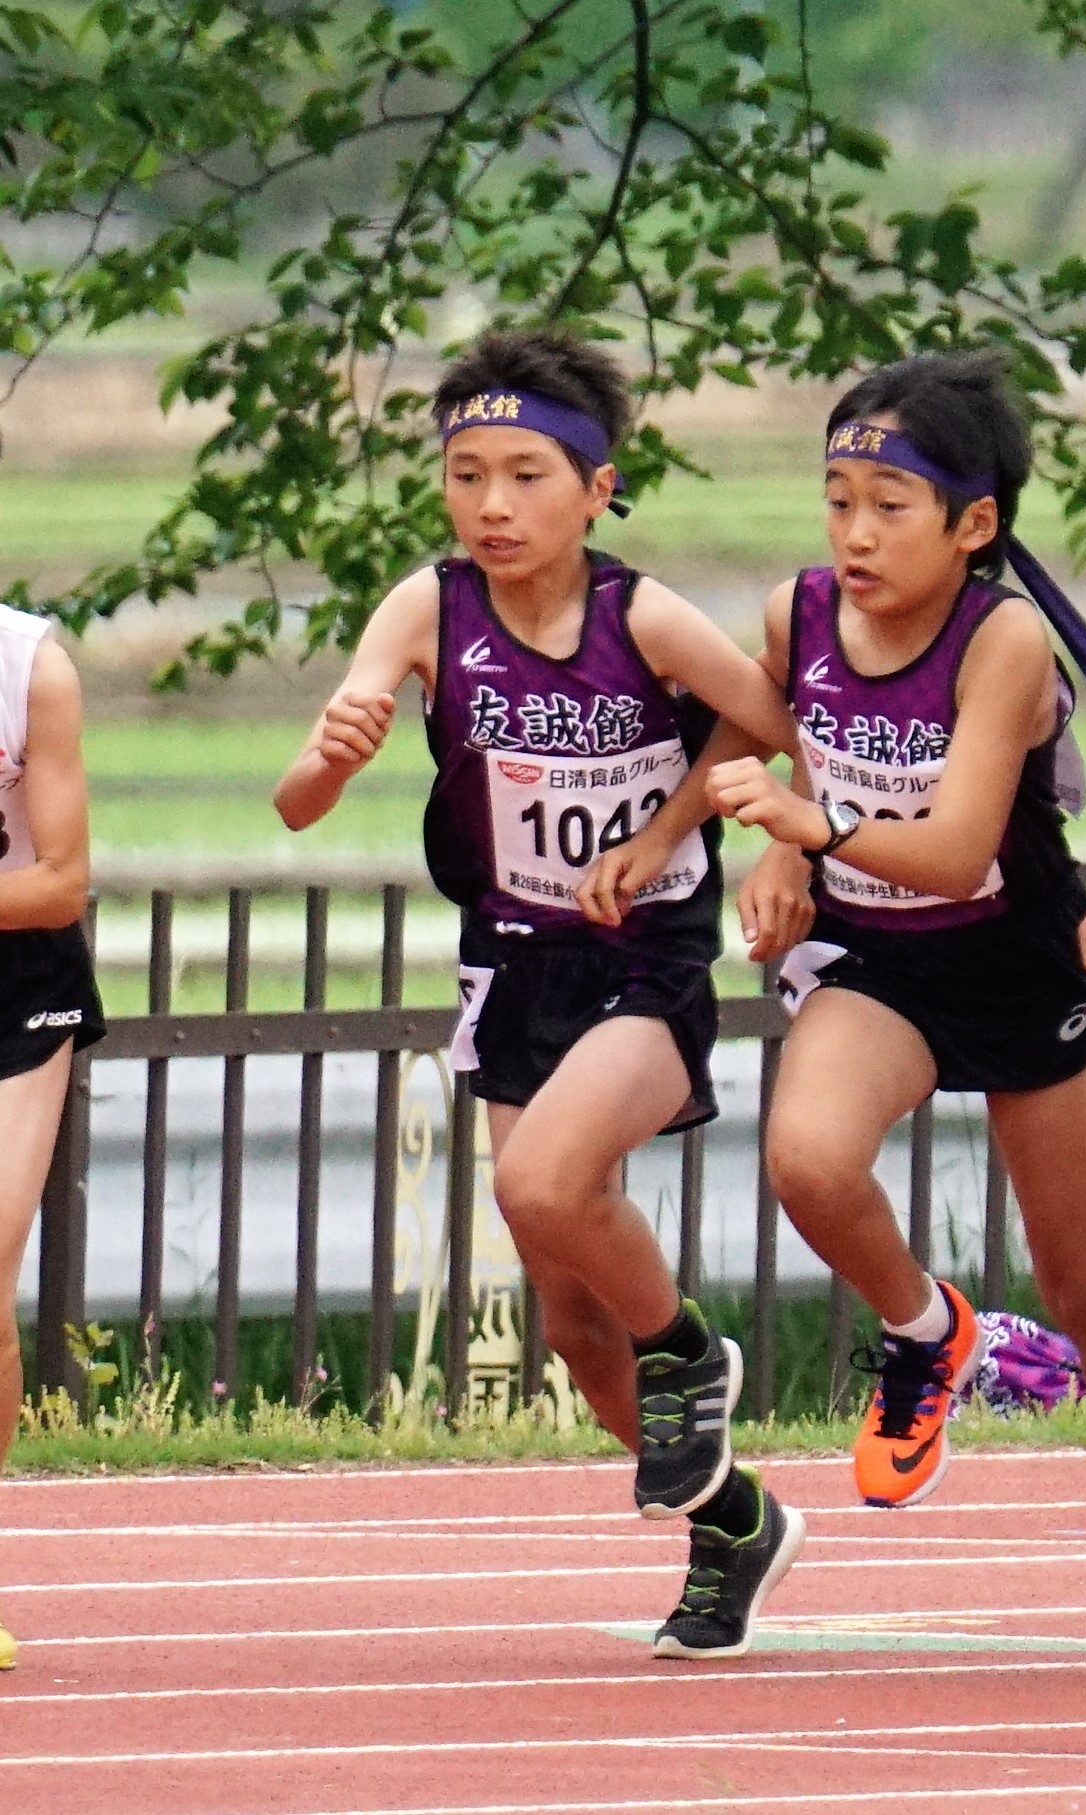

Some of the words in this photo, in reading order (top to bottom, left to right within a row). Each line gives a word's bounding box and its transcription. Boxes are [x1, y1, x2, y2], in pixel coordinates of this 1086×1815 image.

[469, 684, 644, 755] 友誠館
[829, 757, 941, 794] 日清食品グルー
